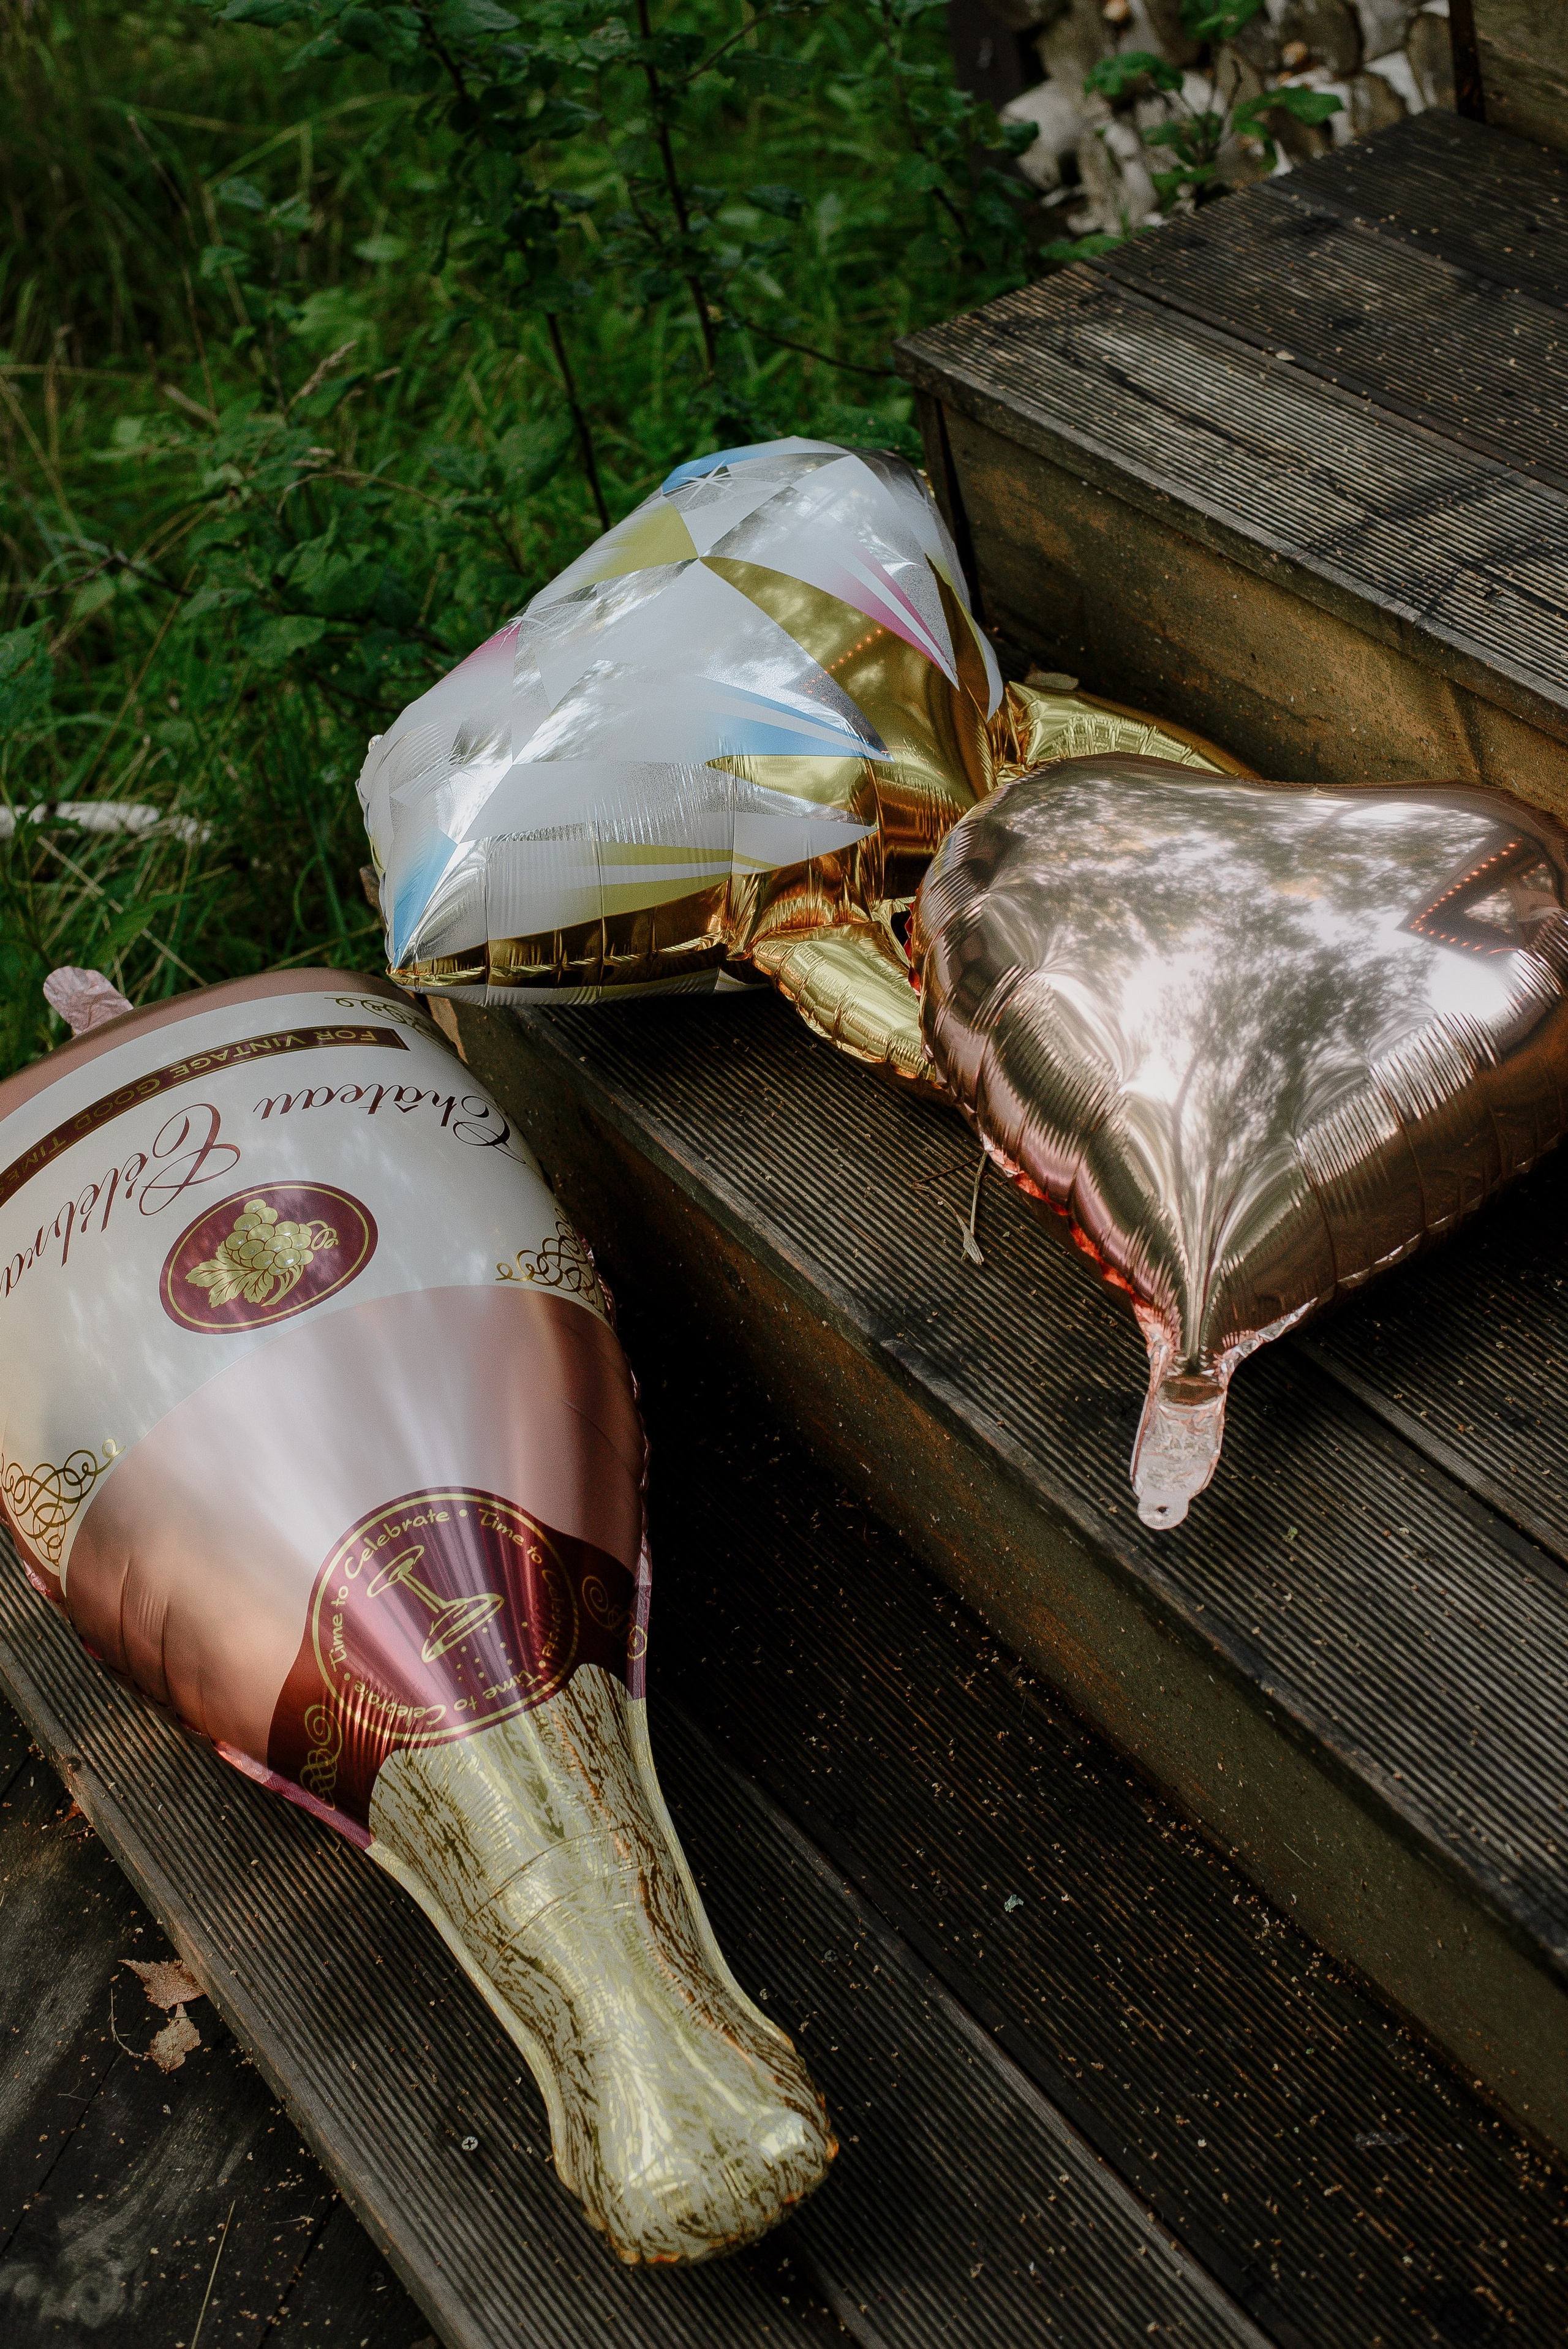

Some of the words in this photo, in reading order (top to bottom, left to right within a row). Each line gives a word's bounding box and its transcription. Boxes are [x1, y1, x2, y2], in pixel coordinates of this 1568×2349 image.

[170, 1035, 306, 1079] VINTAGE
[317, 1030, 377, 1046] FOR
[75, 1077, 162, 1131] GOOD
[254, 1083, 527, 1165] Château
[344, 1509, 450, 1580] Celebrate
[477, 1508, 526, 1545] Time
[527, 1545, 543, 1564] to
[331, 1585, 350, 1608] to
[329, 1613, 346, 1673] Time
[454, 1697, 479, 1712] to
[482, 1670, 543, 1699] Time
